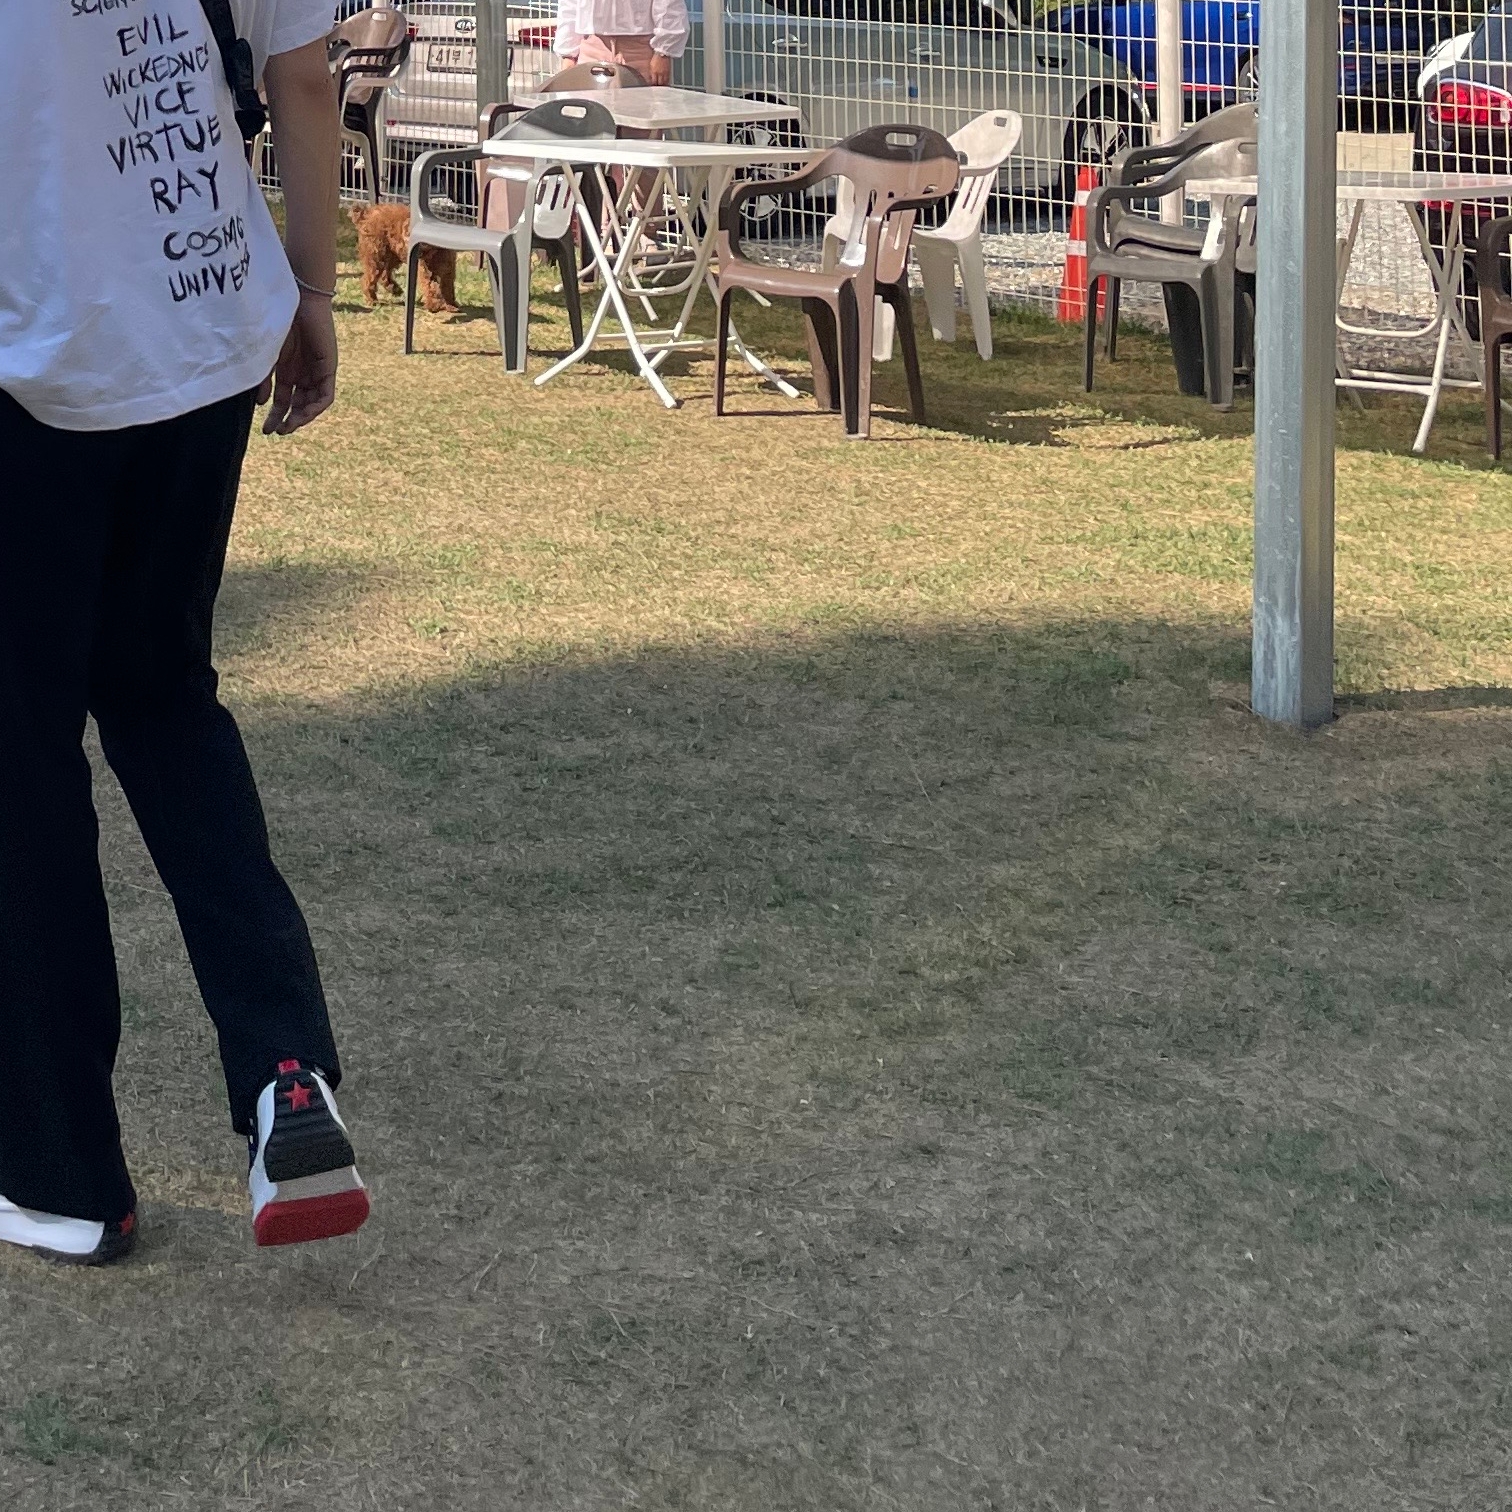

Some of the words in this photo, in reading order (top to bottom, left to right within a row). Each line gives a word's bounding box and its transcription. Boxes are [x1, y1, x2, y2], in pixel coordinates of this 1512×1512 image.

[116, 12, 189, 57] EVIL
[122, 81, 200, 129] VICE
[106, 114, 222, 175] VIRTUE
[149, 160, 220, 214] RAY
